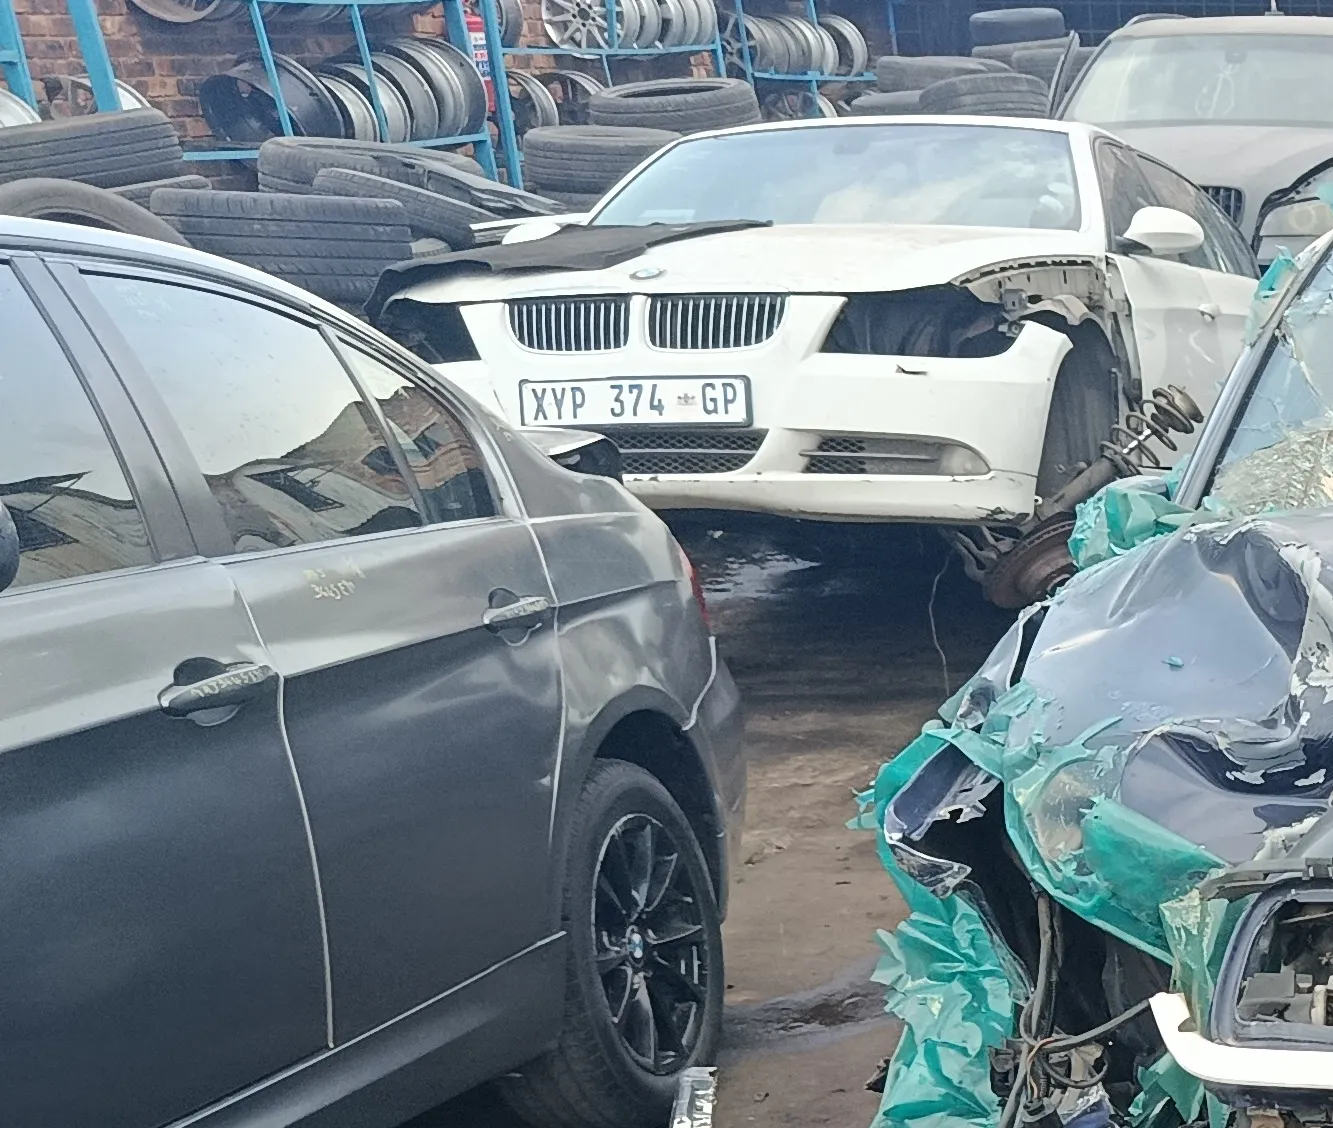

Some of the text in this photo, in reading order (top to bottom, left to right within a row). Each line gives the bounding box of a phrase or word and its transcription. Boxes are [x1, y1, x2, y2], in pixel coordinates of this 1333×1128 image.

[531, 382, 738, 421] XYP 374 GP
